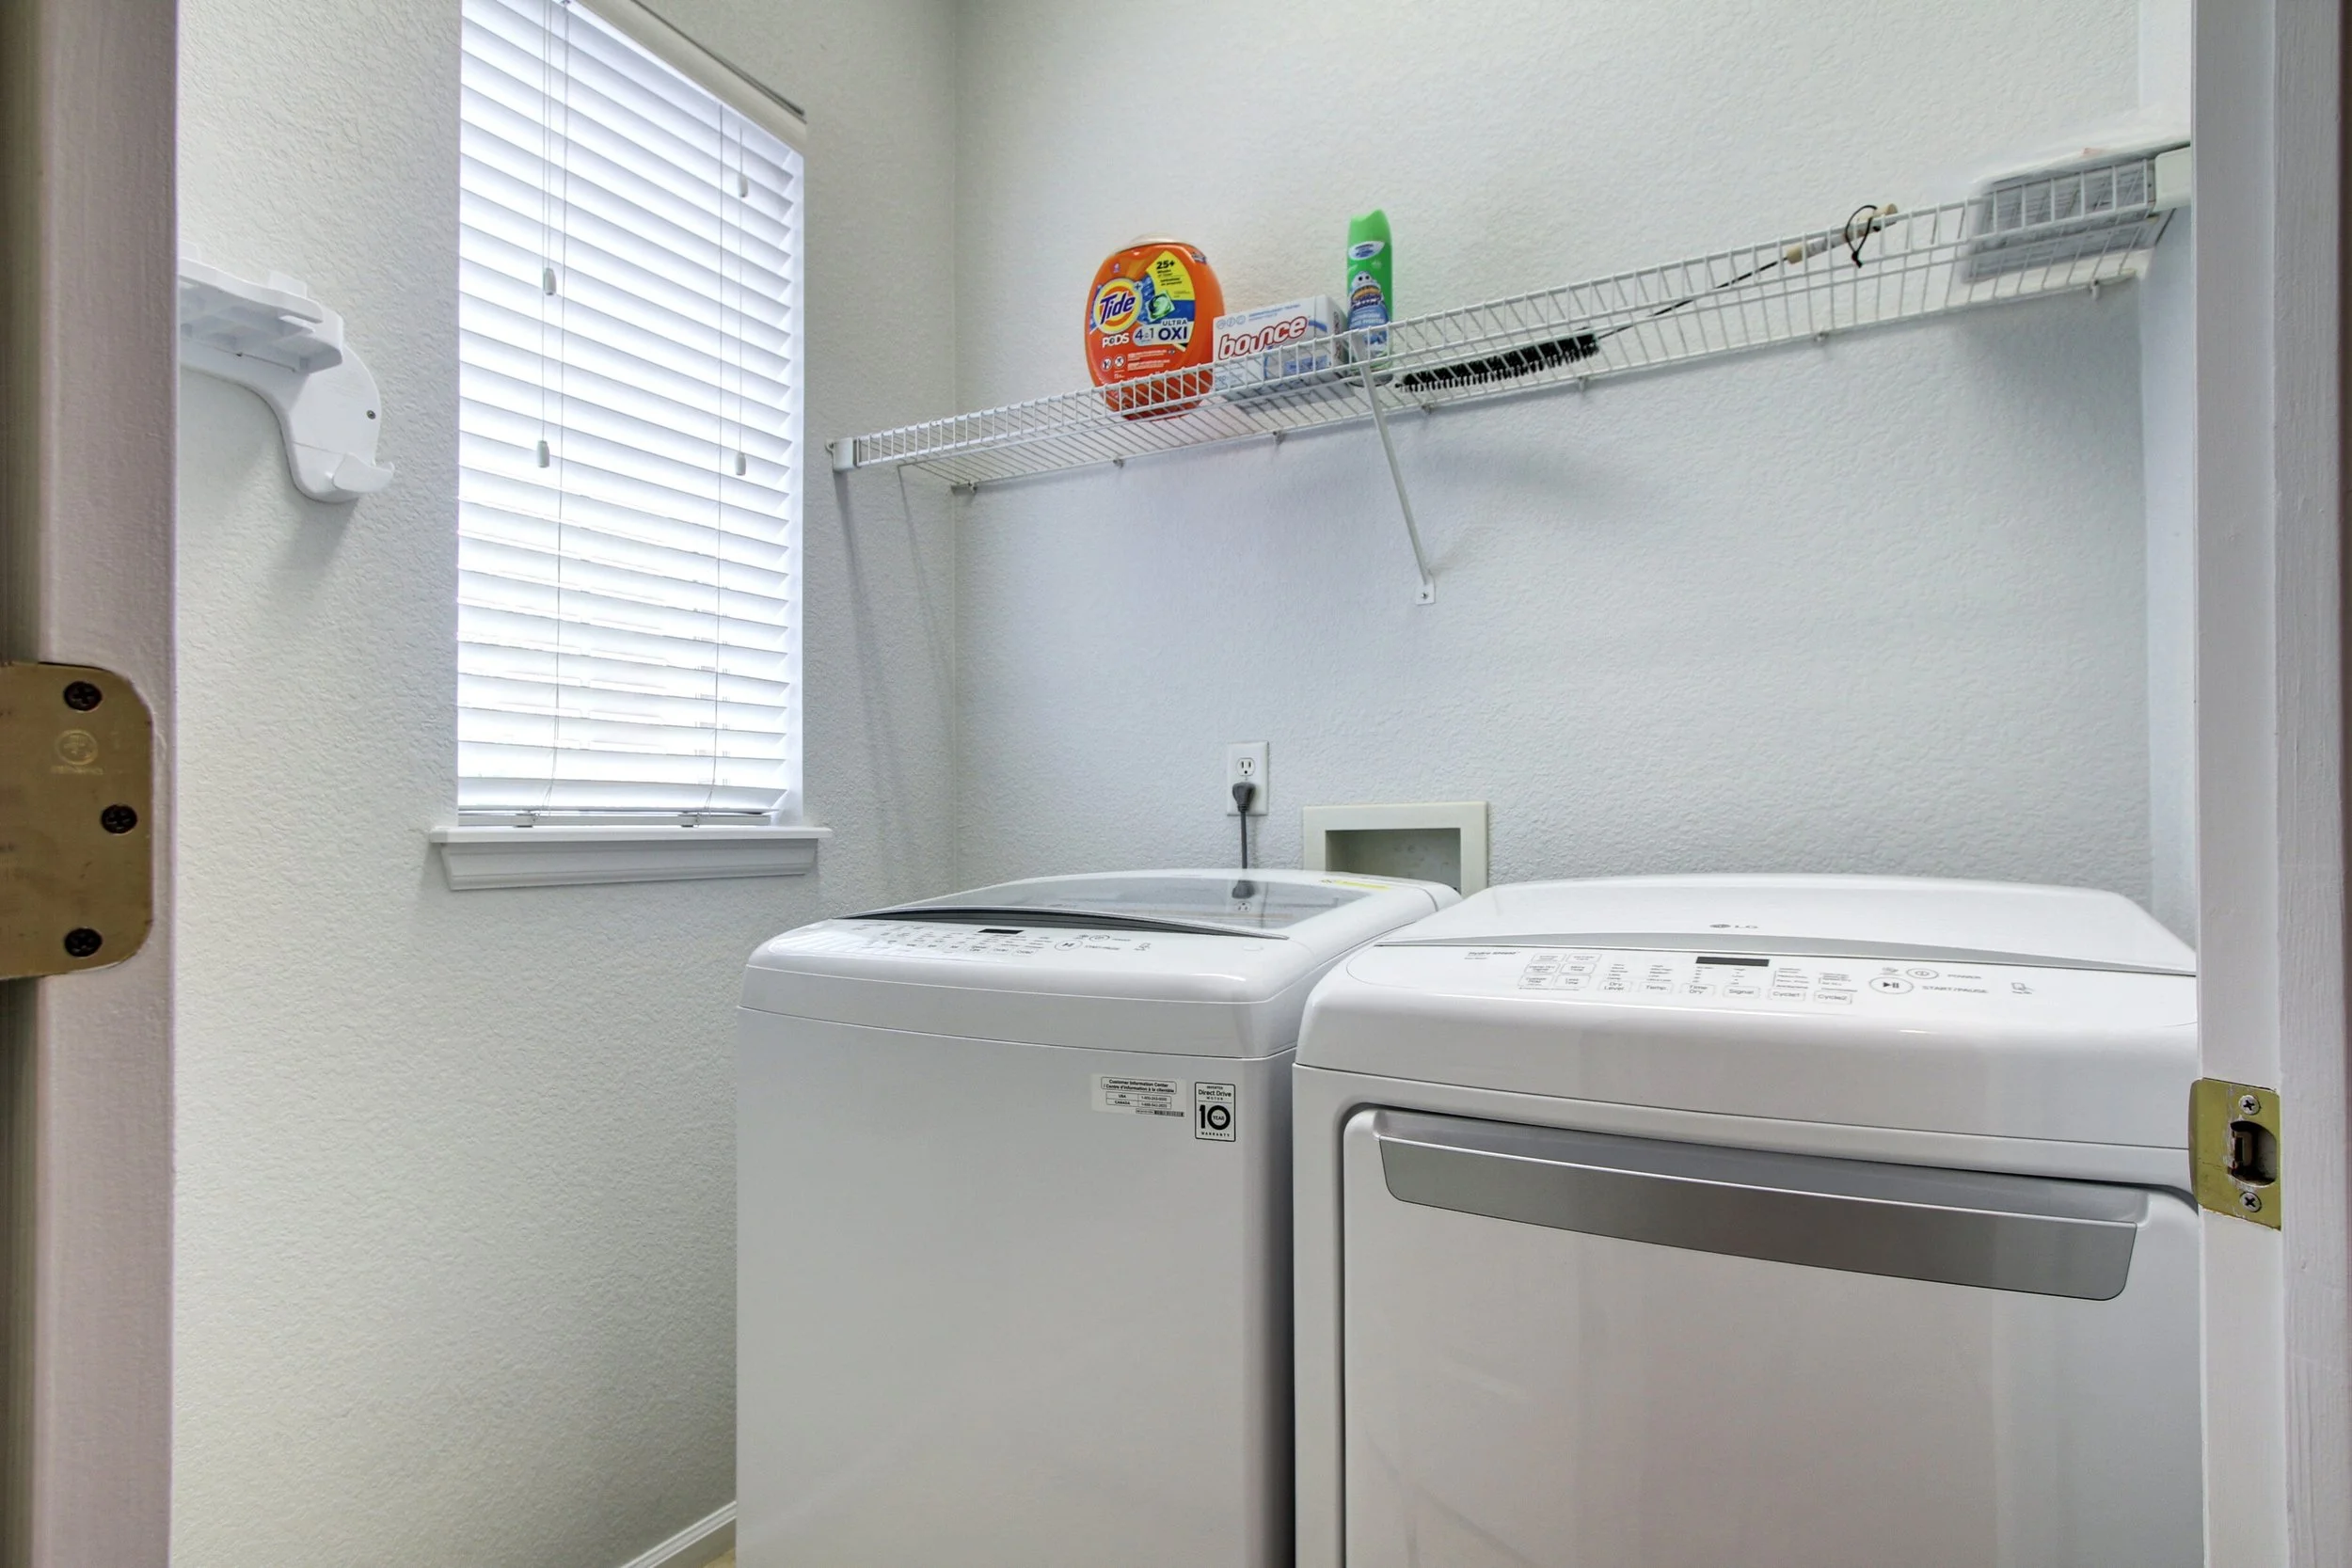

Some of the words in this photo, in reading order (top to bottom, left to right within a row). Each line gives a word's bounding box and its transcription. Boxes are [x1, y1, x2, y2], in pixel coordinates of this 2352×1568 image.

[1156, 260, 1175, 270] 25+
[1100, 292, 1136, 325] Tide
[1103, 333, 1129, 348] PODS
[1158, 326, 1187, 341] OXI
[1218, 316, 1308, 360] bounce
[1200, 1104, 1231, 1130] 10
